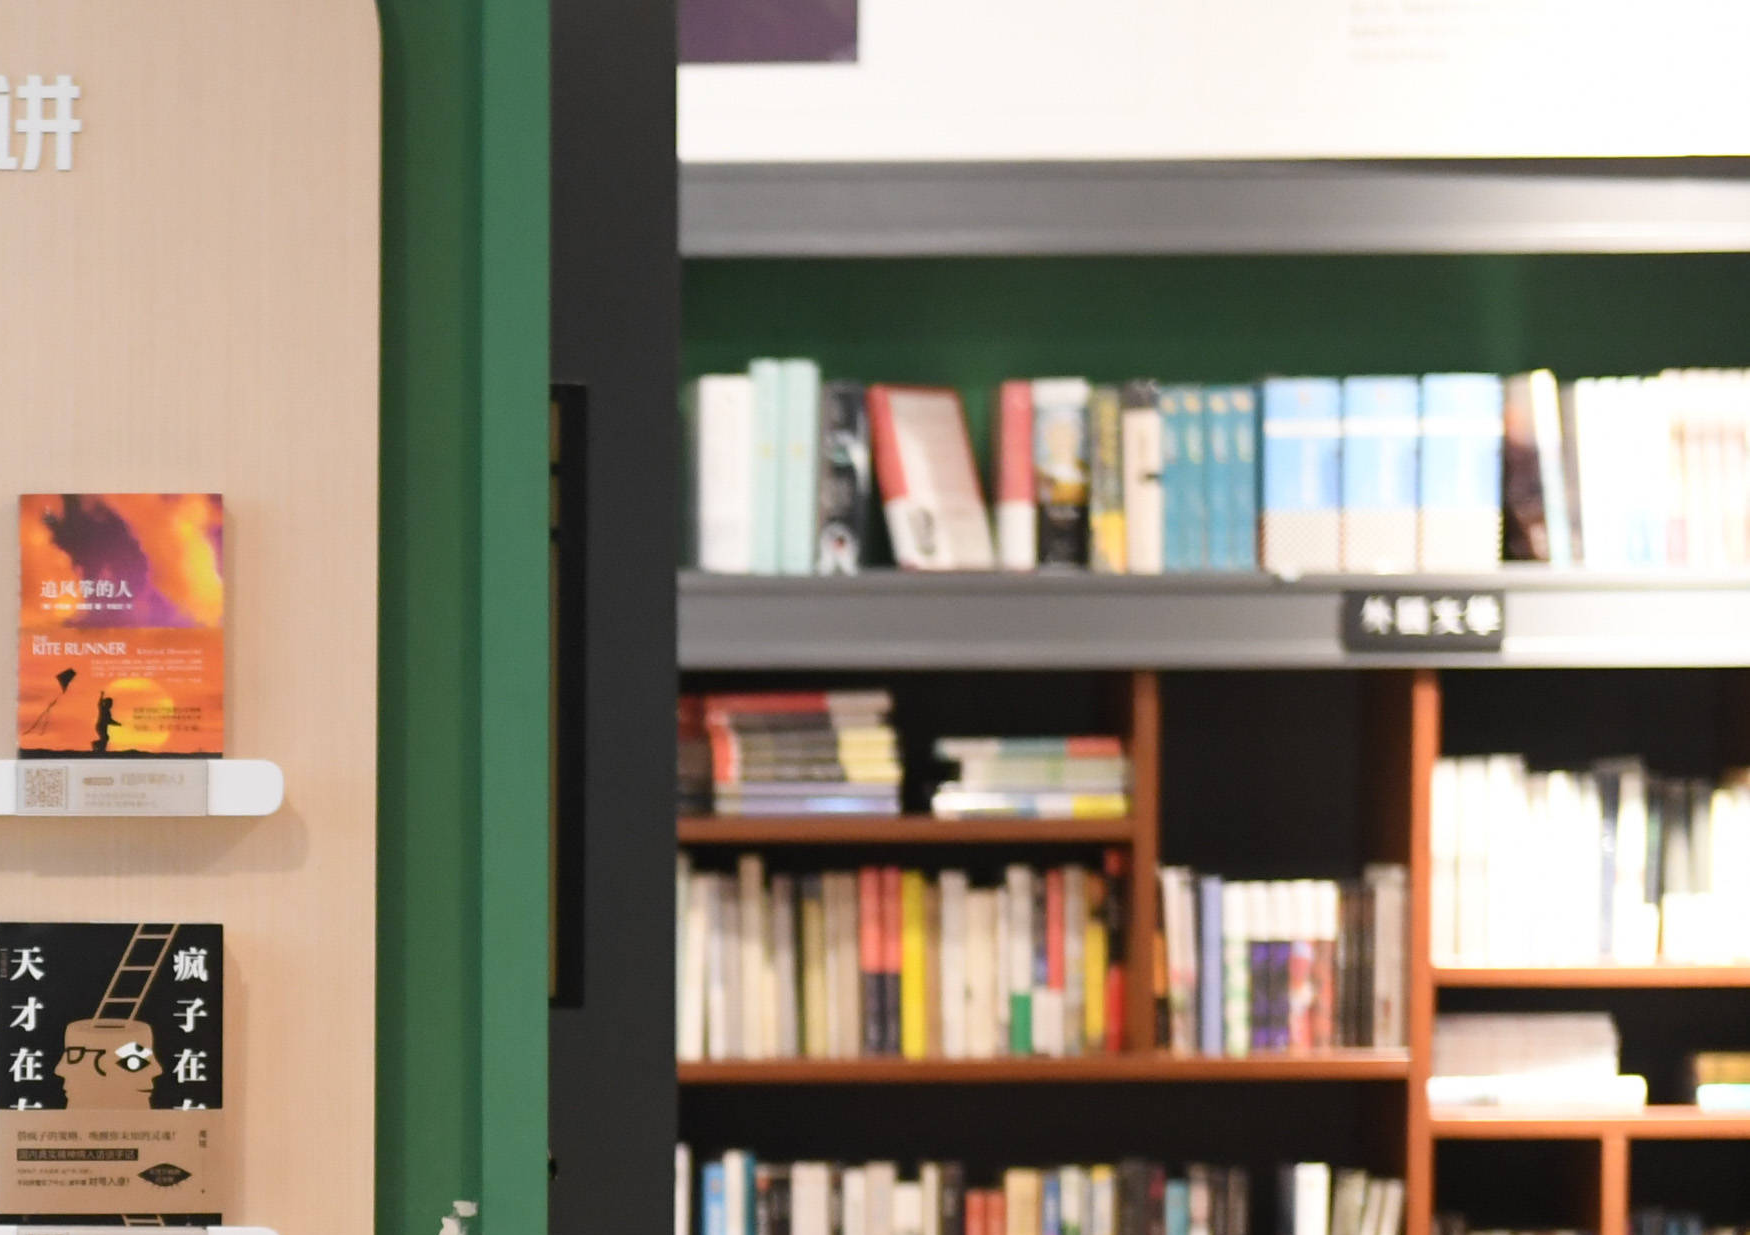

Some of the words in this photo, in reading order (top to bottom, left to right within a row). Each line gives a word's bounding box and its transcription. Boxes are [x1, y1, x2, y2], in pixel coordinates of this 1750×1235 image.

[40, 579, 134, 599] 追风筝的人
[32, 642, 61, 656] KITE
[64, 642, 127, 656] RUNNER
